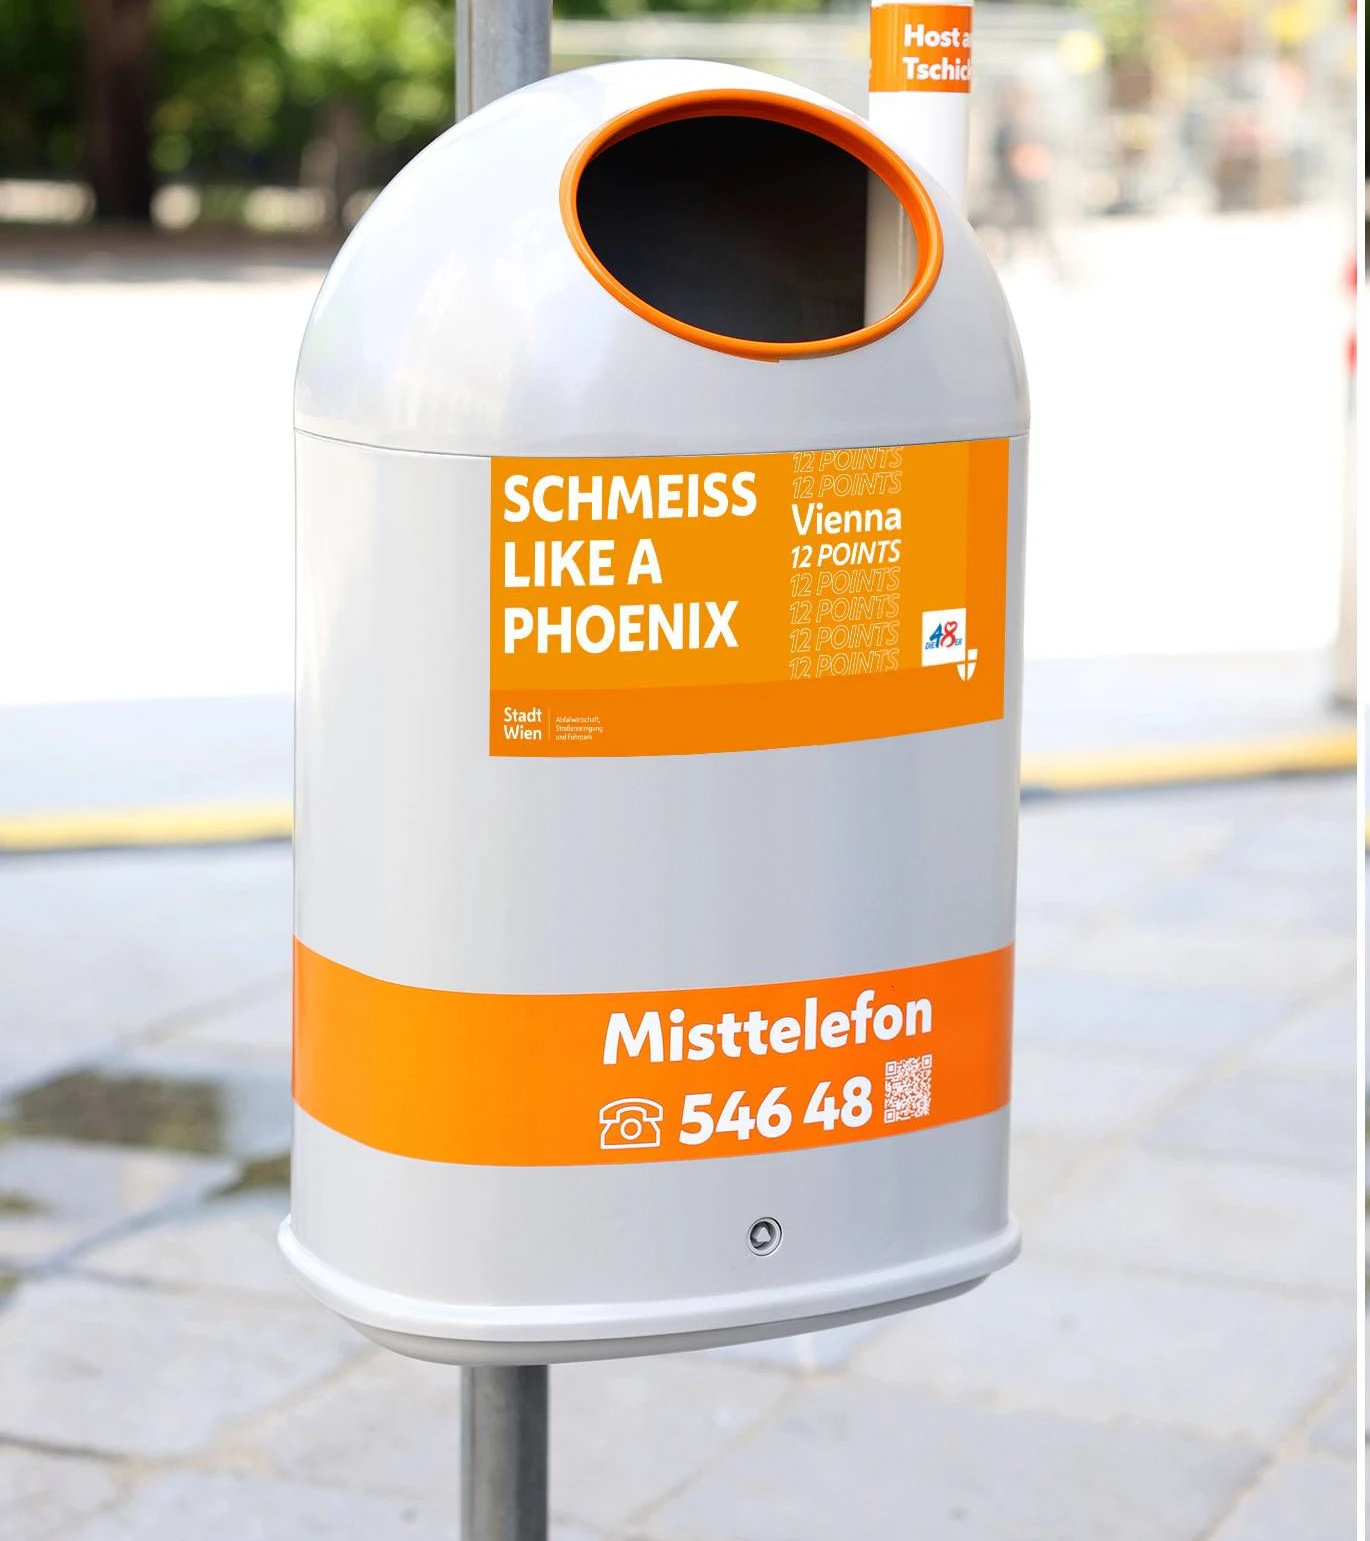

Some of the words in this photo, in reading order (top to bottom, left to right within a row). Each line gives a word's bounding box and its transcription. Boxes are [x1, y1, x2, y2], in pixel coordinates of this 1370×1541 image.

[904, 23, 960, 48] Host
[792, 451, 816, 473] 12
[818, 447, 904, 471] POINTS
[503, 471, 757, 523] SCHMEISS
[792, 476, 815, 499] 12
[818, 470, 903, 497] POINTS
[791, 502, 902, 536] Vienna
[504, 540, 615, 588] LIKE
[627, 538, 663, 585] A
[791, 544, 813, 569] 12
[817, 538, 902, 567] POINTS
[790, 573, 813, 597] 12
[816, 566, 901, 595] POINTS
[789, 601, 813, 625] 12
[816, 593, 901, 623] POINTS
[504, 600, 739, 654] PHOENIX
[789, 628, 812, 653] 12
[816, 620, 900, 651] POINTS
[789, 656, 812, 680] 12
[816, 648, 900, 678] POINTS
[503, 706, 543, 723] Stadt
[503, 724, 542, 741] Wien
[602, 989, 933, 1065] Misttelefon
[679, 1086, 792, 1145] 546
[803, 1076, 873, 1130] 48
